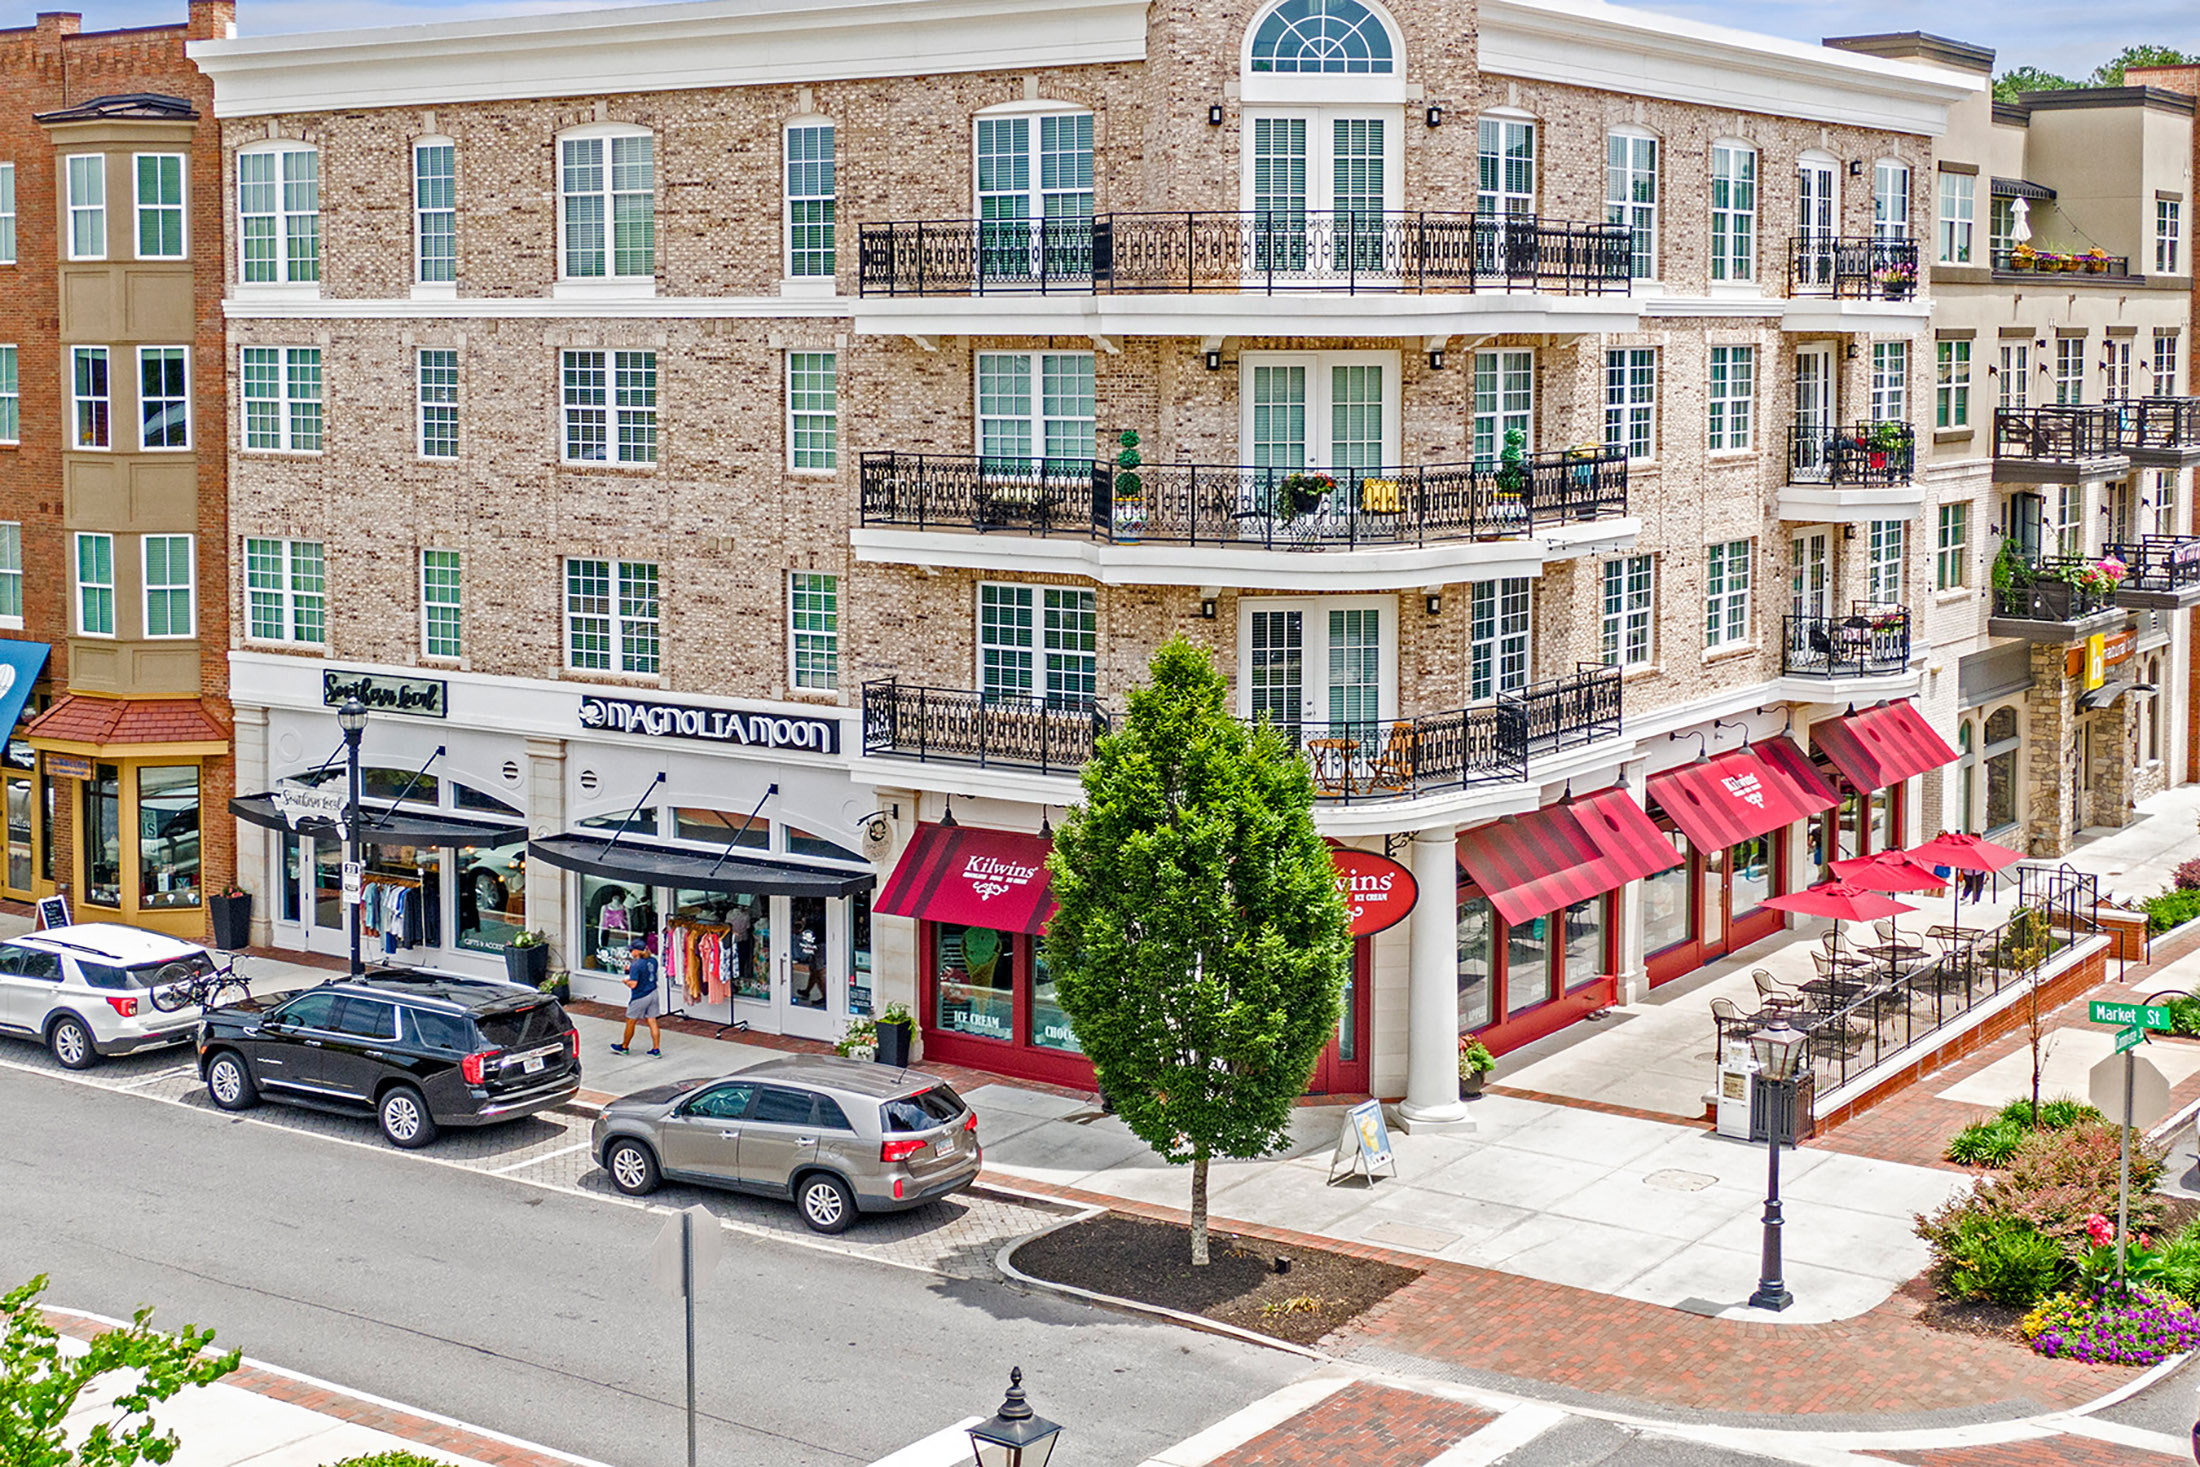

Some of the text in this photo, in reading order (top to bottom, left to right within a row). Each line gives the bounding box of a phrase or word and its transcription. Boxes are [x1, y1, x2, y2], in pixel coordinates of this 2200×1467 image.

[325, 673, 397, 707] Southern
[964, 855, 1036, 879] Kilwins
[954, 1010, 999, 1029] ICE CREAM
[2096, 1004, 2161, 1025] Market St
